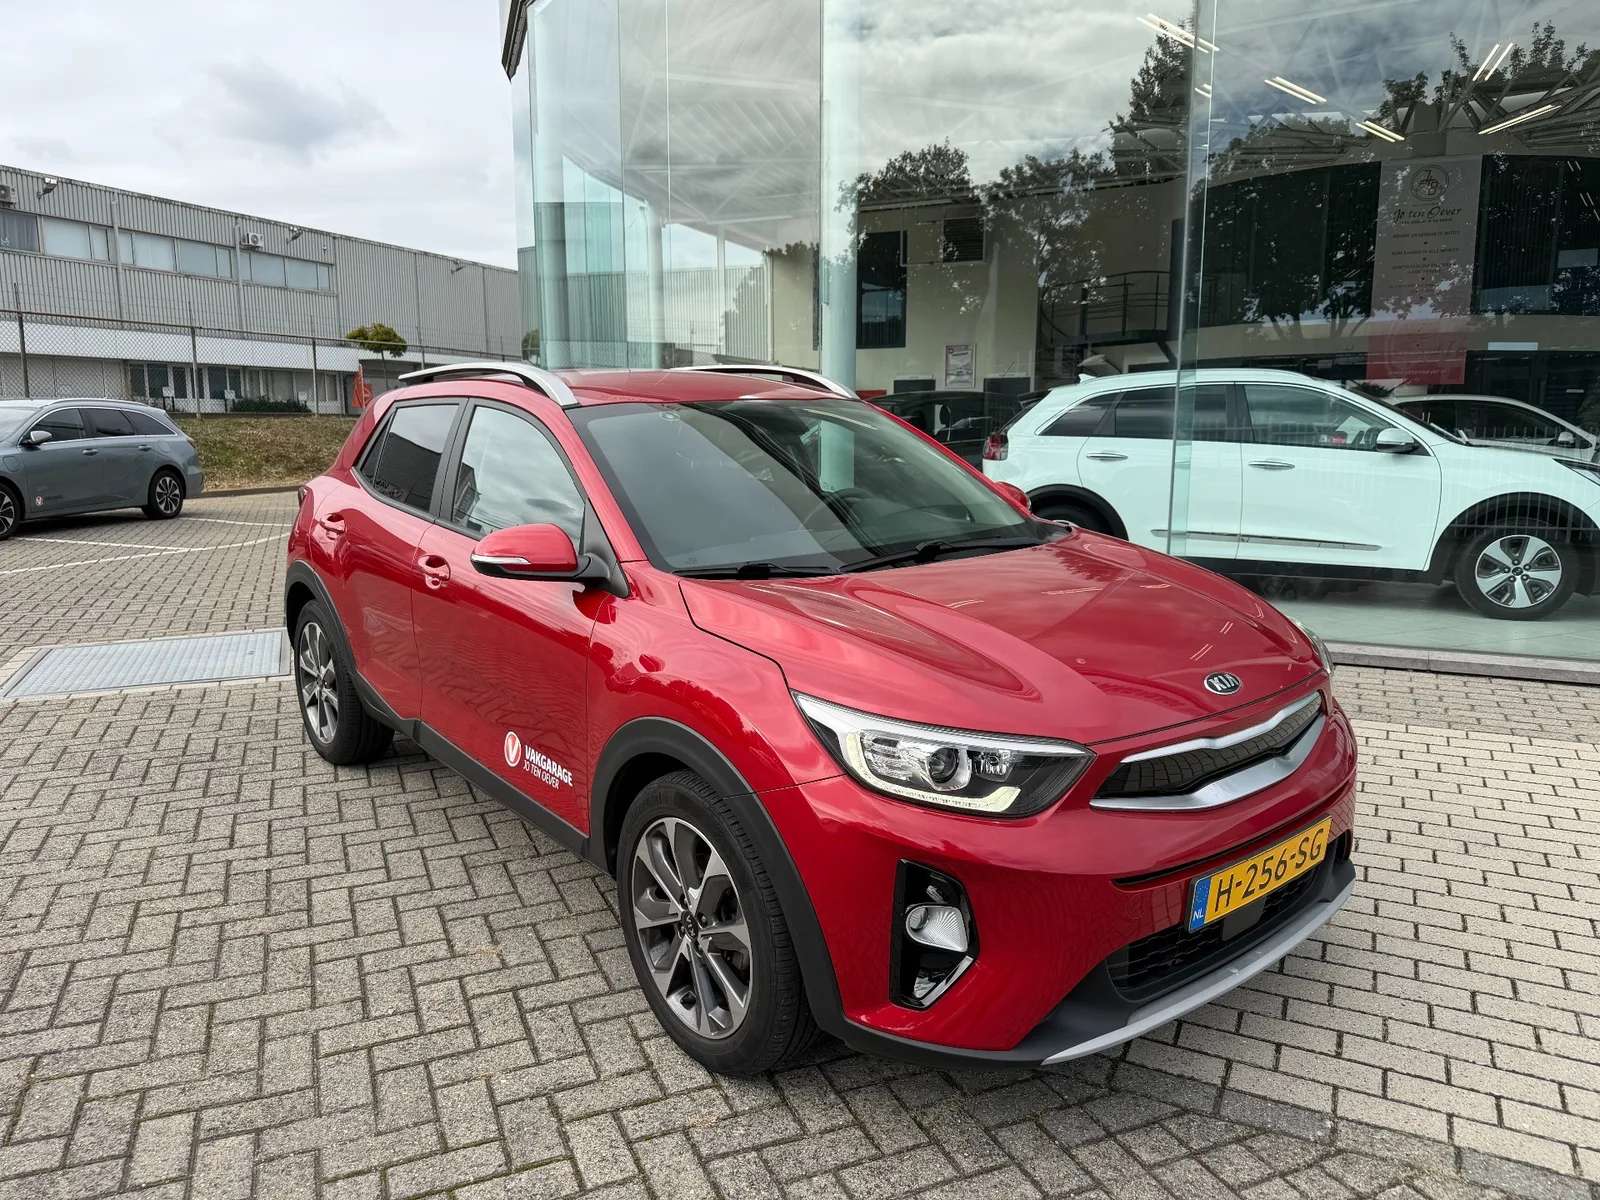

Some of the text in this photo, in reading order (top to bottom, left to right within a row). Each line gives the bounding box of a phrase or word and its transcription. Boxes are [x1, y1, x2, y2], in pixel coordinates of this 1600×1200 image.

[1408, 209, 1425, 219] ten
[1427, 206, 1462, 219] Oever
[1208, 674, 1239, 691] KIA
[523, 760, 560, 790] JO TEN OEVER
[525, 744, 573, 787] VAKGARAGE
[1214, 828, 1324, 912] H-256-SG
[1193, 908, 1204, 921] NL
